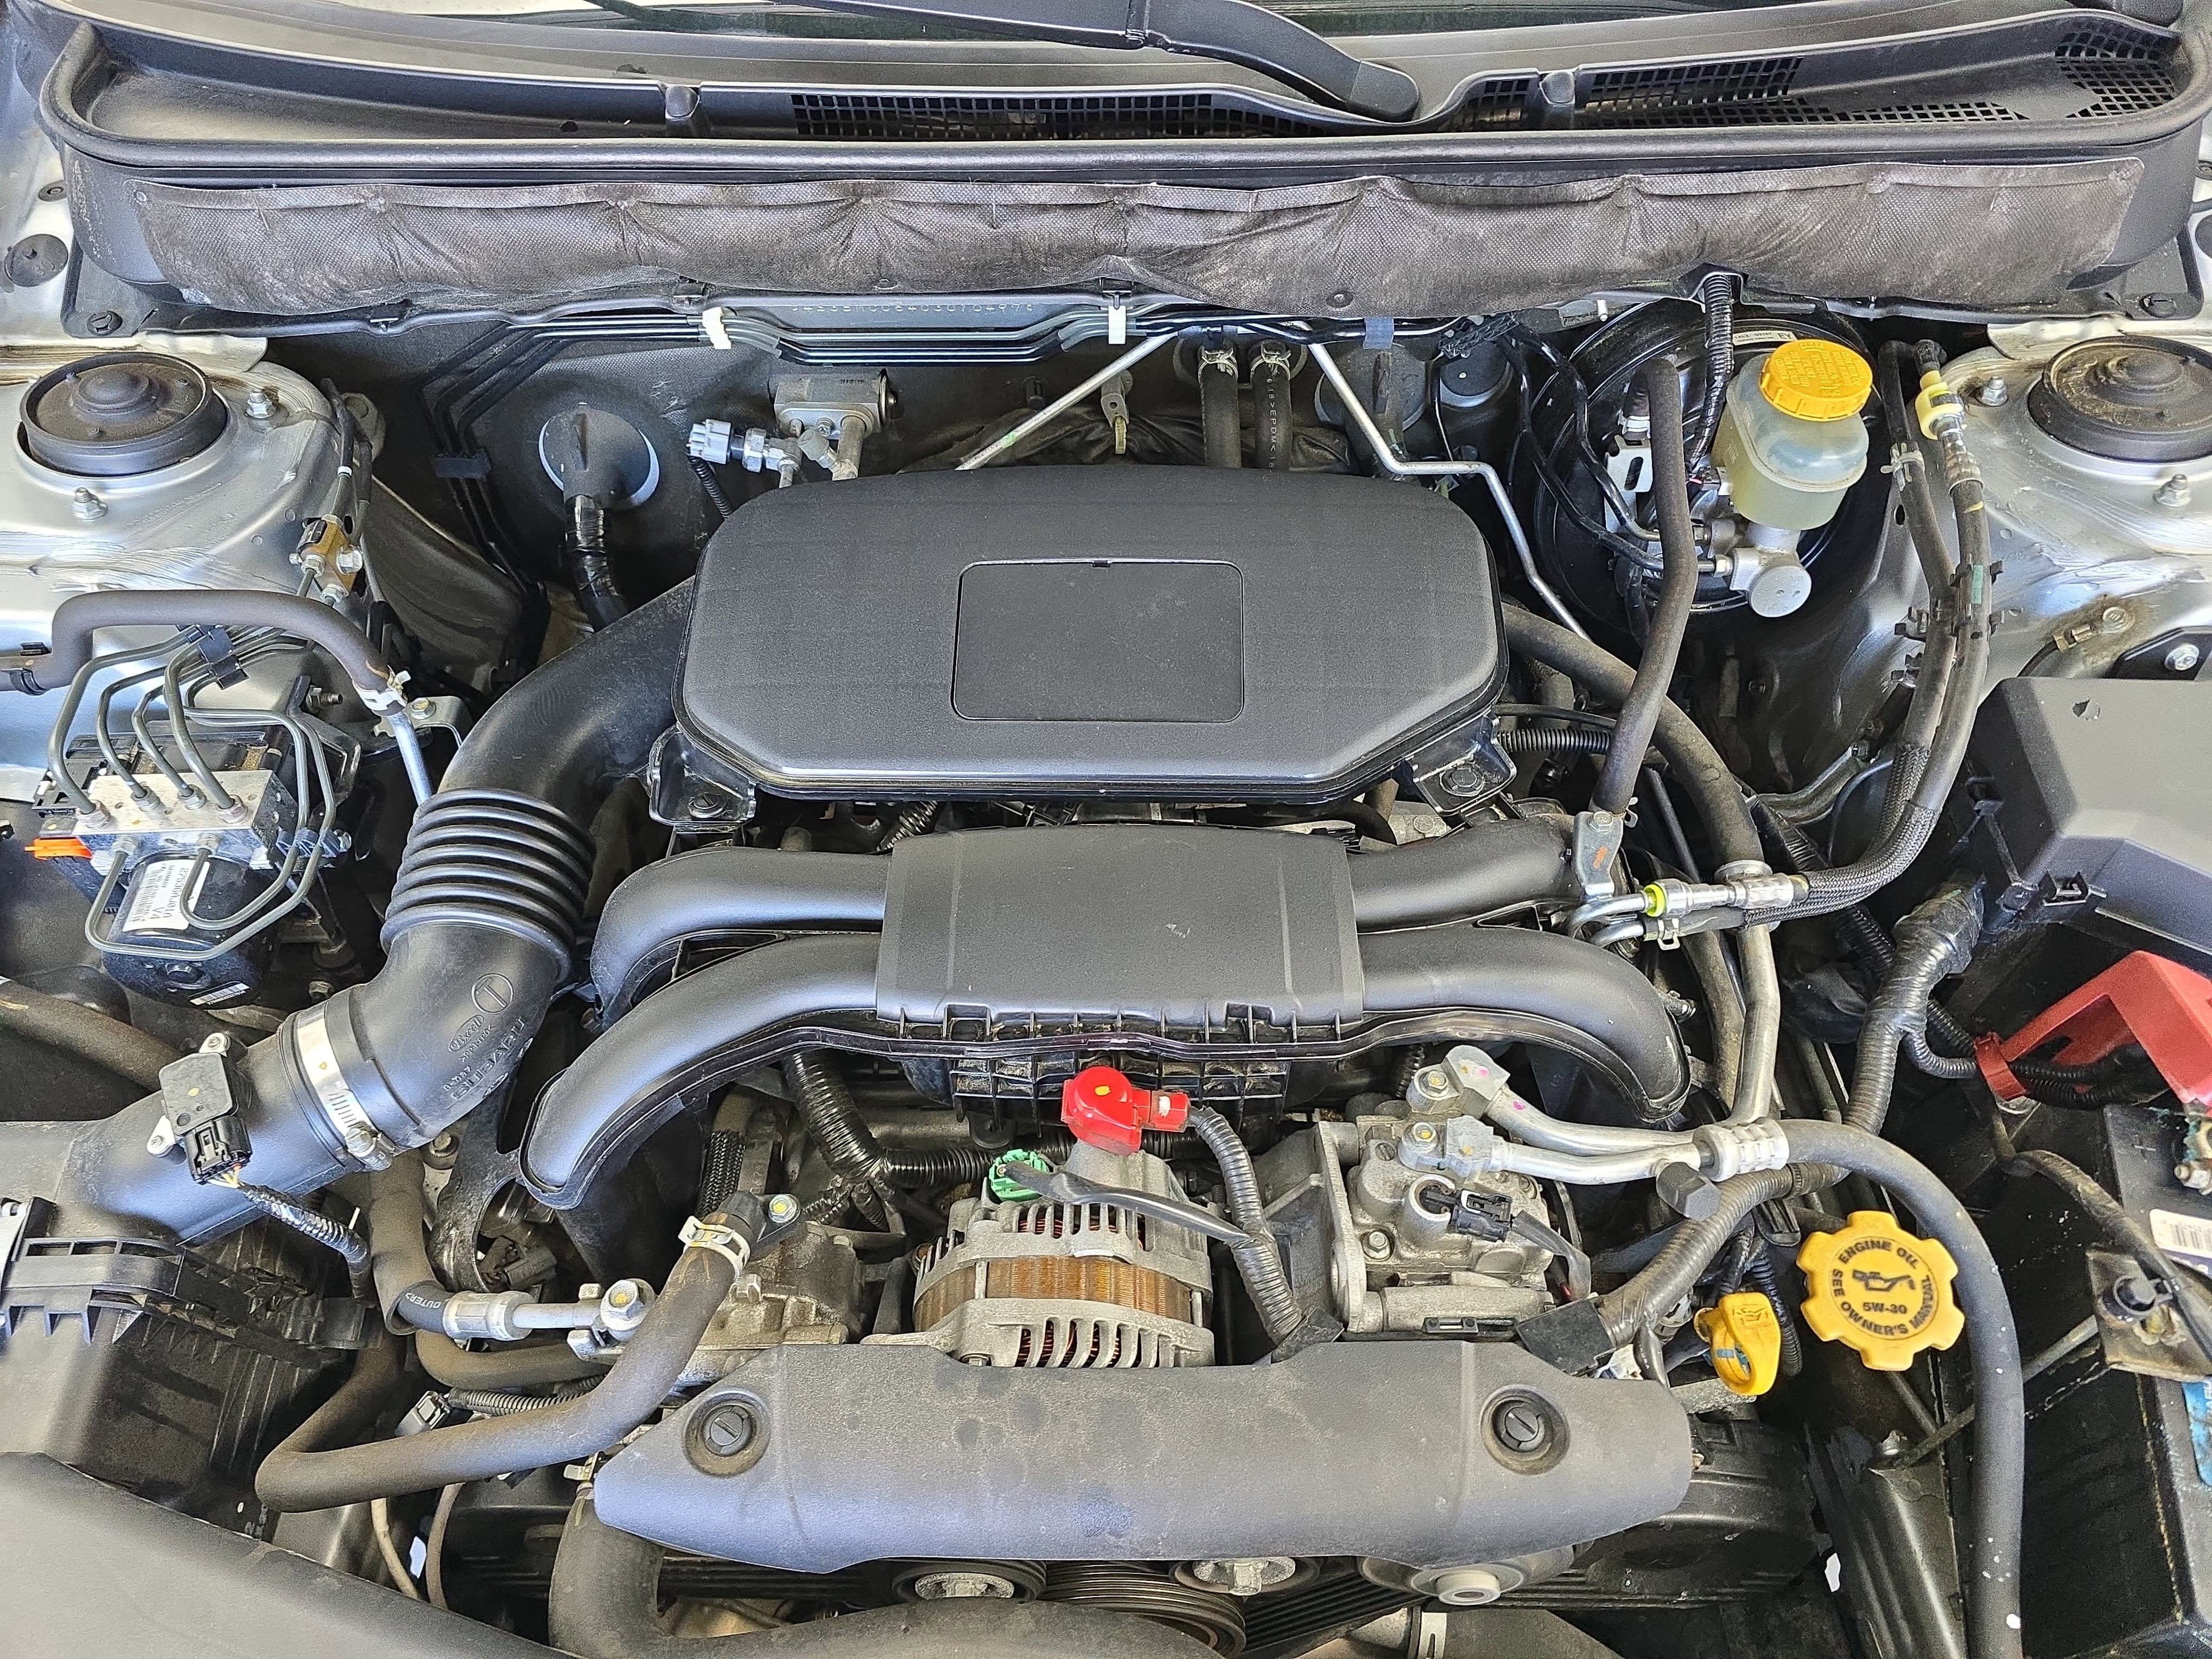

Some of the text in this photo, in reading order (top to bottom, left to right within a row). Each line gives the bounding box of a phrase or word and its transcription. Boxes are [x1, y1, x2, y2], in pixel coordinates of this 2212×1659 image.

[452, 1015, 525, 1100] SUBARU
[1838, 1239, 1920, 1270] ENGINE OIL
[1832, 1268, 1934, 1336] SEE OWNER'S MANUAL
[1862, 1301, 1908, 1315] 5W-30
